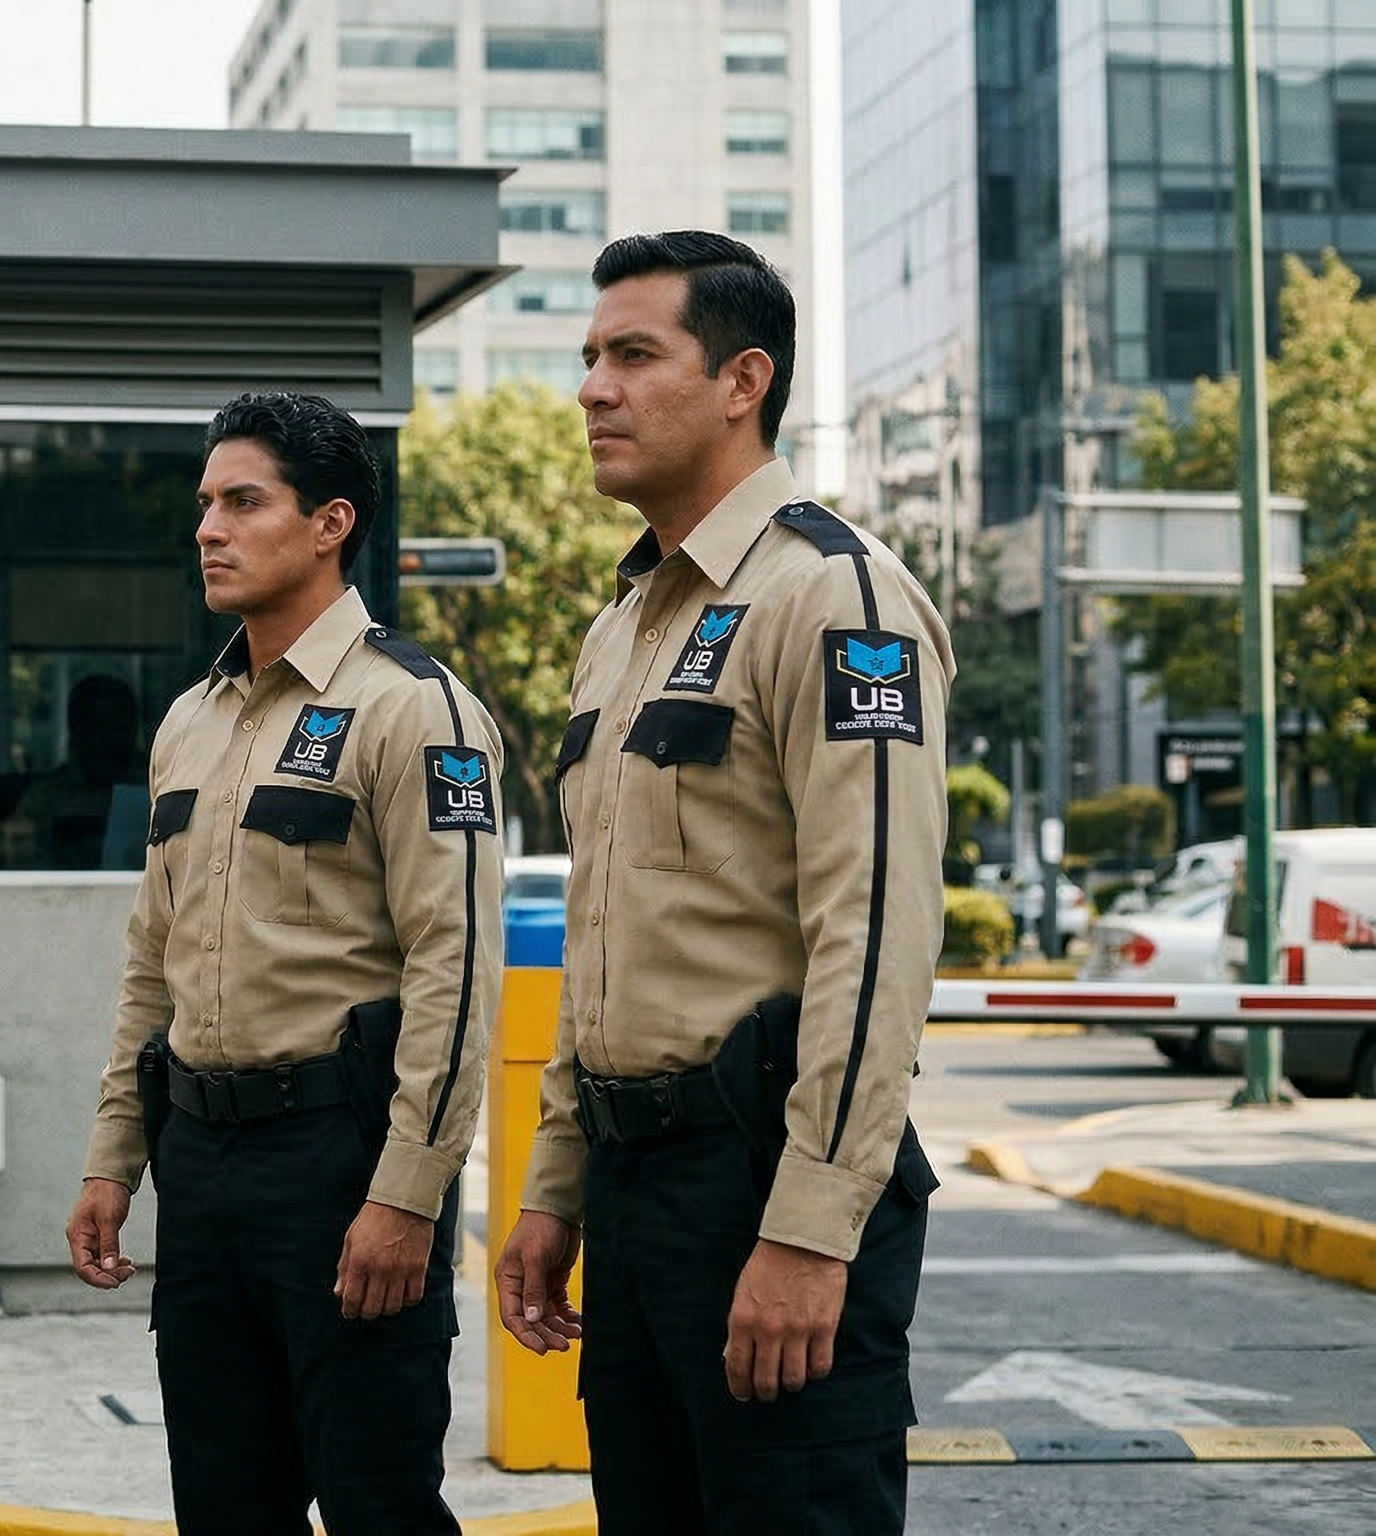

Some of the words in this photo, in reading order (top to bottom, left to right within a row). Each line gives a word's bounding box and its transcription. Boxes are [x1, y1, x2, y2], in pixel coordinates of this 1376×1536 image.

[683, 650, 714, 671] UB
[850, 686, 904, 712] UB
[294, 741, 328, 761] UB
[447, 789, 485, 809] UB
